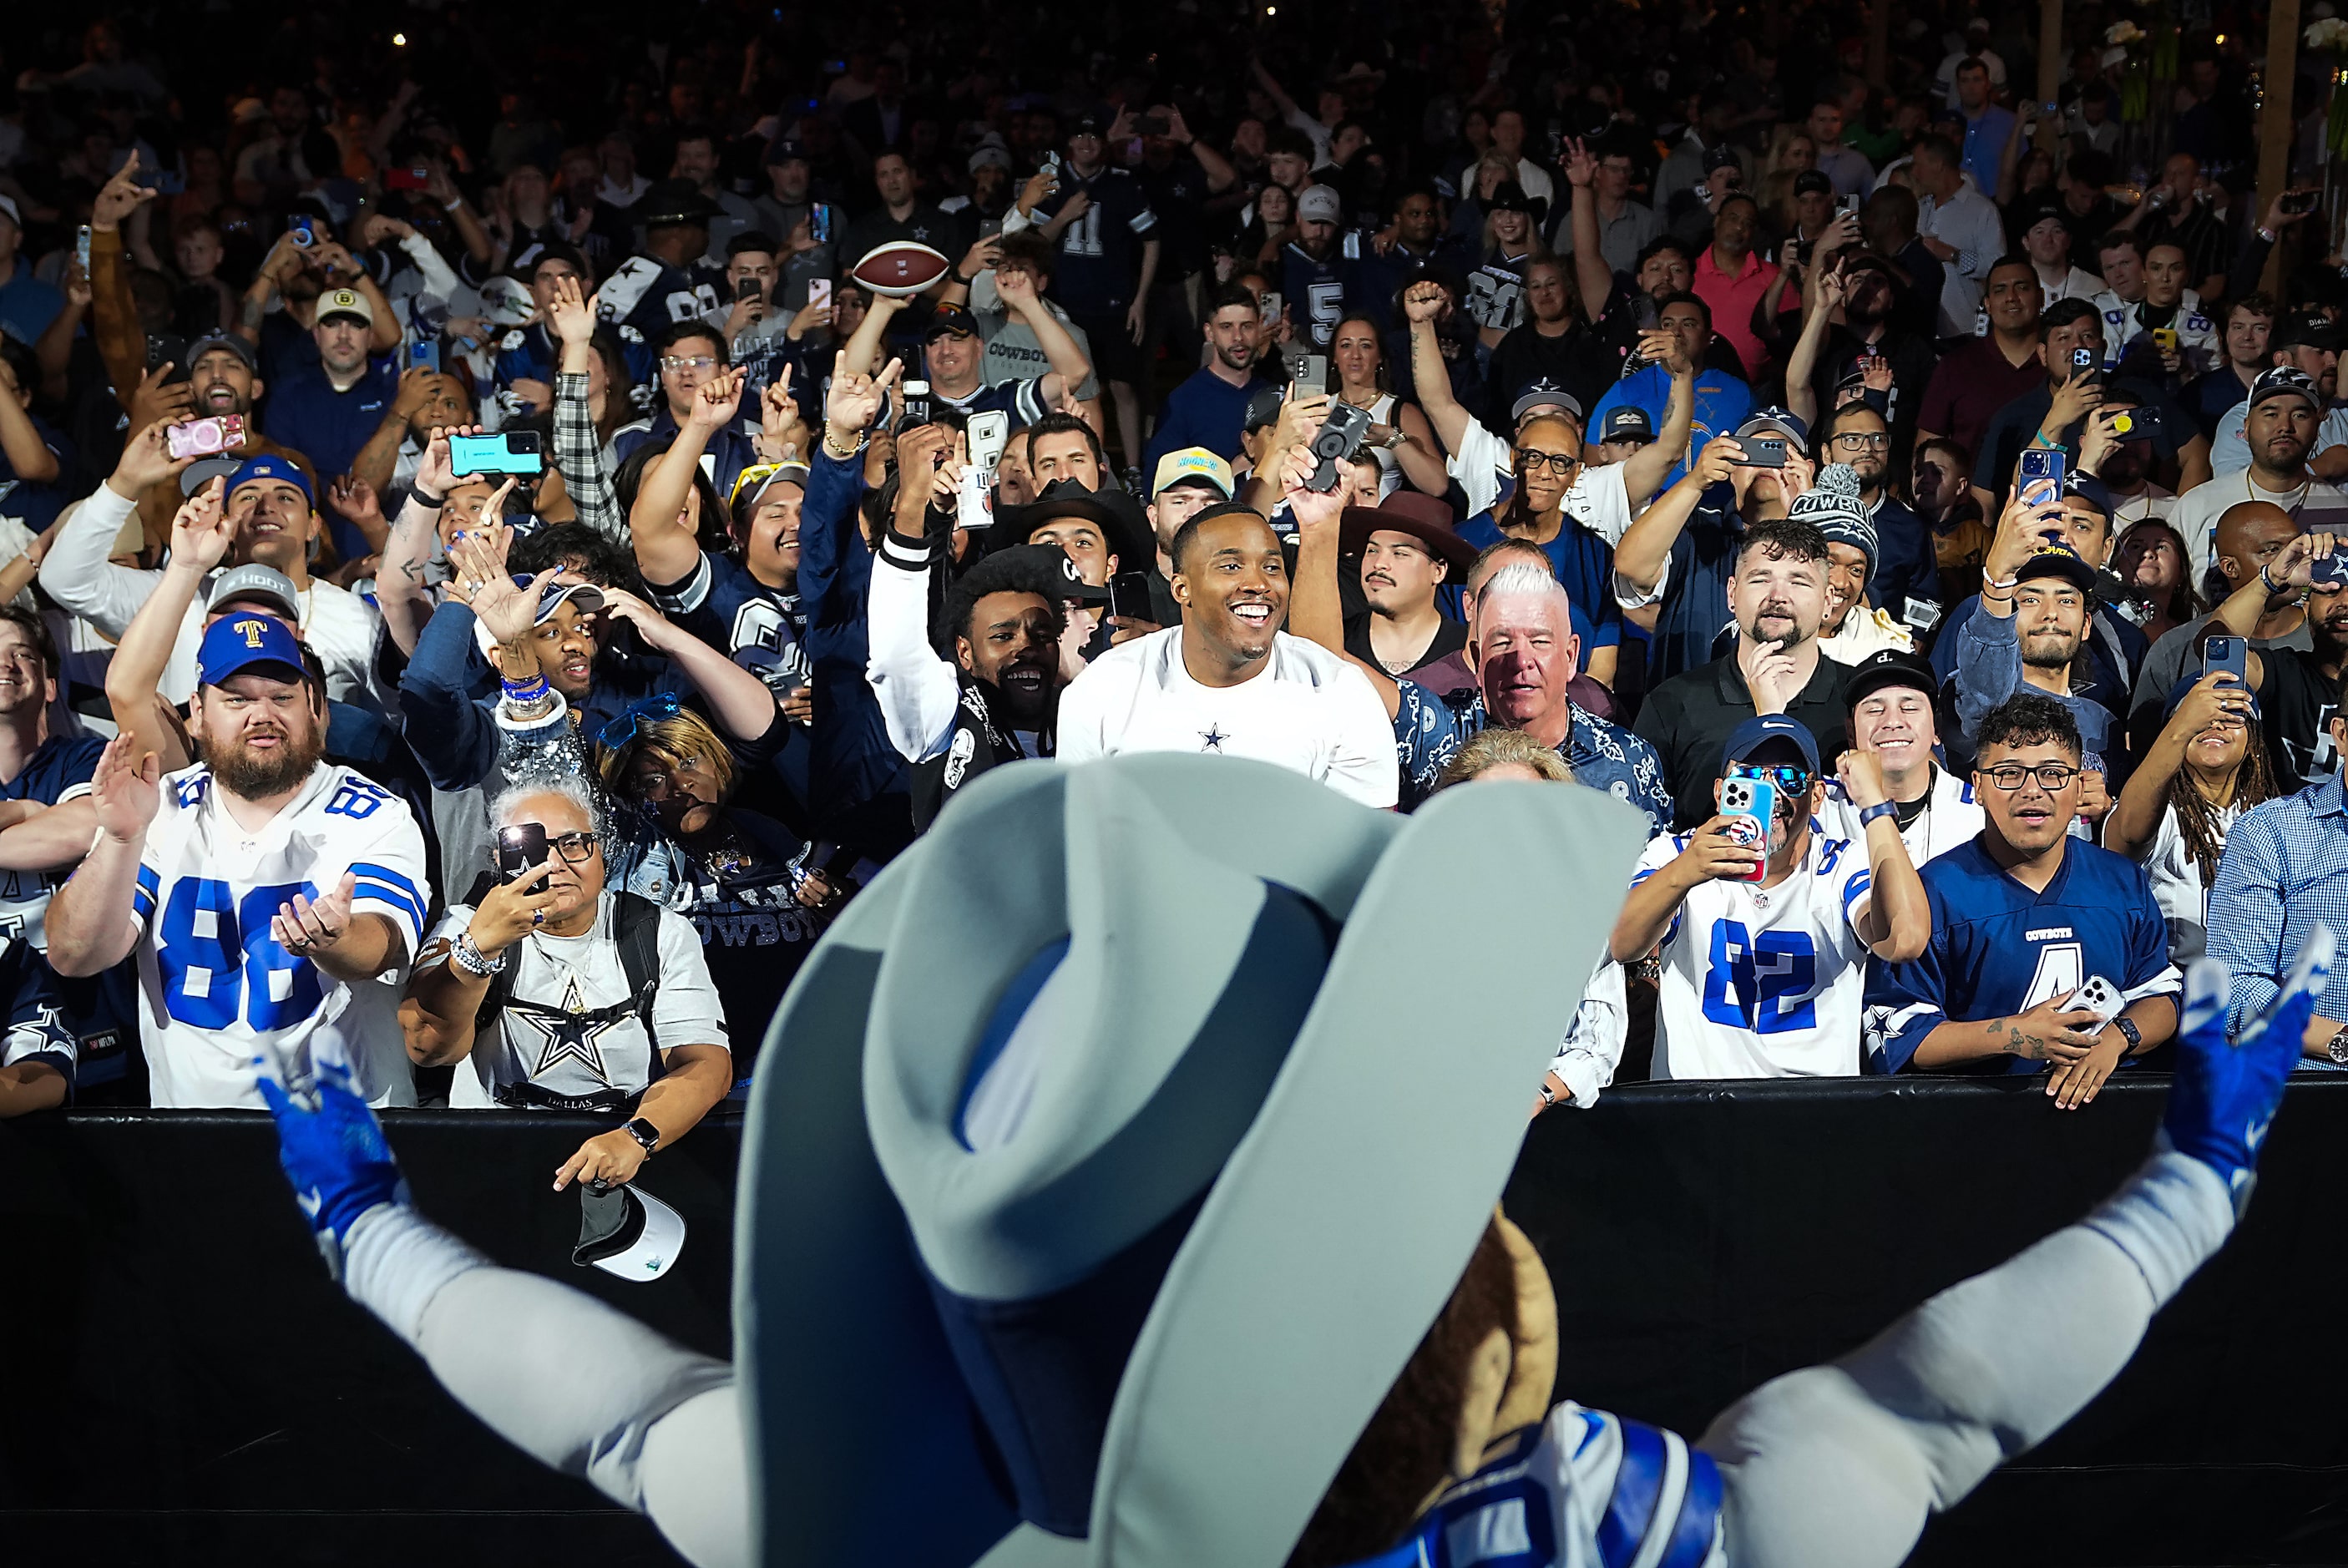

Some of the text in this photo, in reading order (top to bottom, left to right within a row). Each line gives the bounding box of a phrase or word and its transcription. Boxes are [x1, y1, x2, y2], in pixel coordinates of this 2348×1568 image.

[1308, 282, 1344, 347] 5
[233, 619, 268, 649] T
[157, 876, 324, 1033] 88
[2025, 926, 2073, 943] COWBOYS
[1702, 918, 1817, 1034] 82
